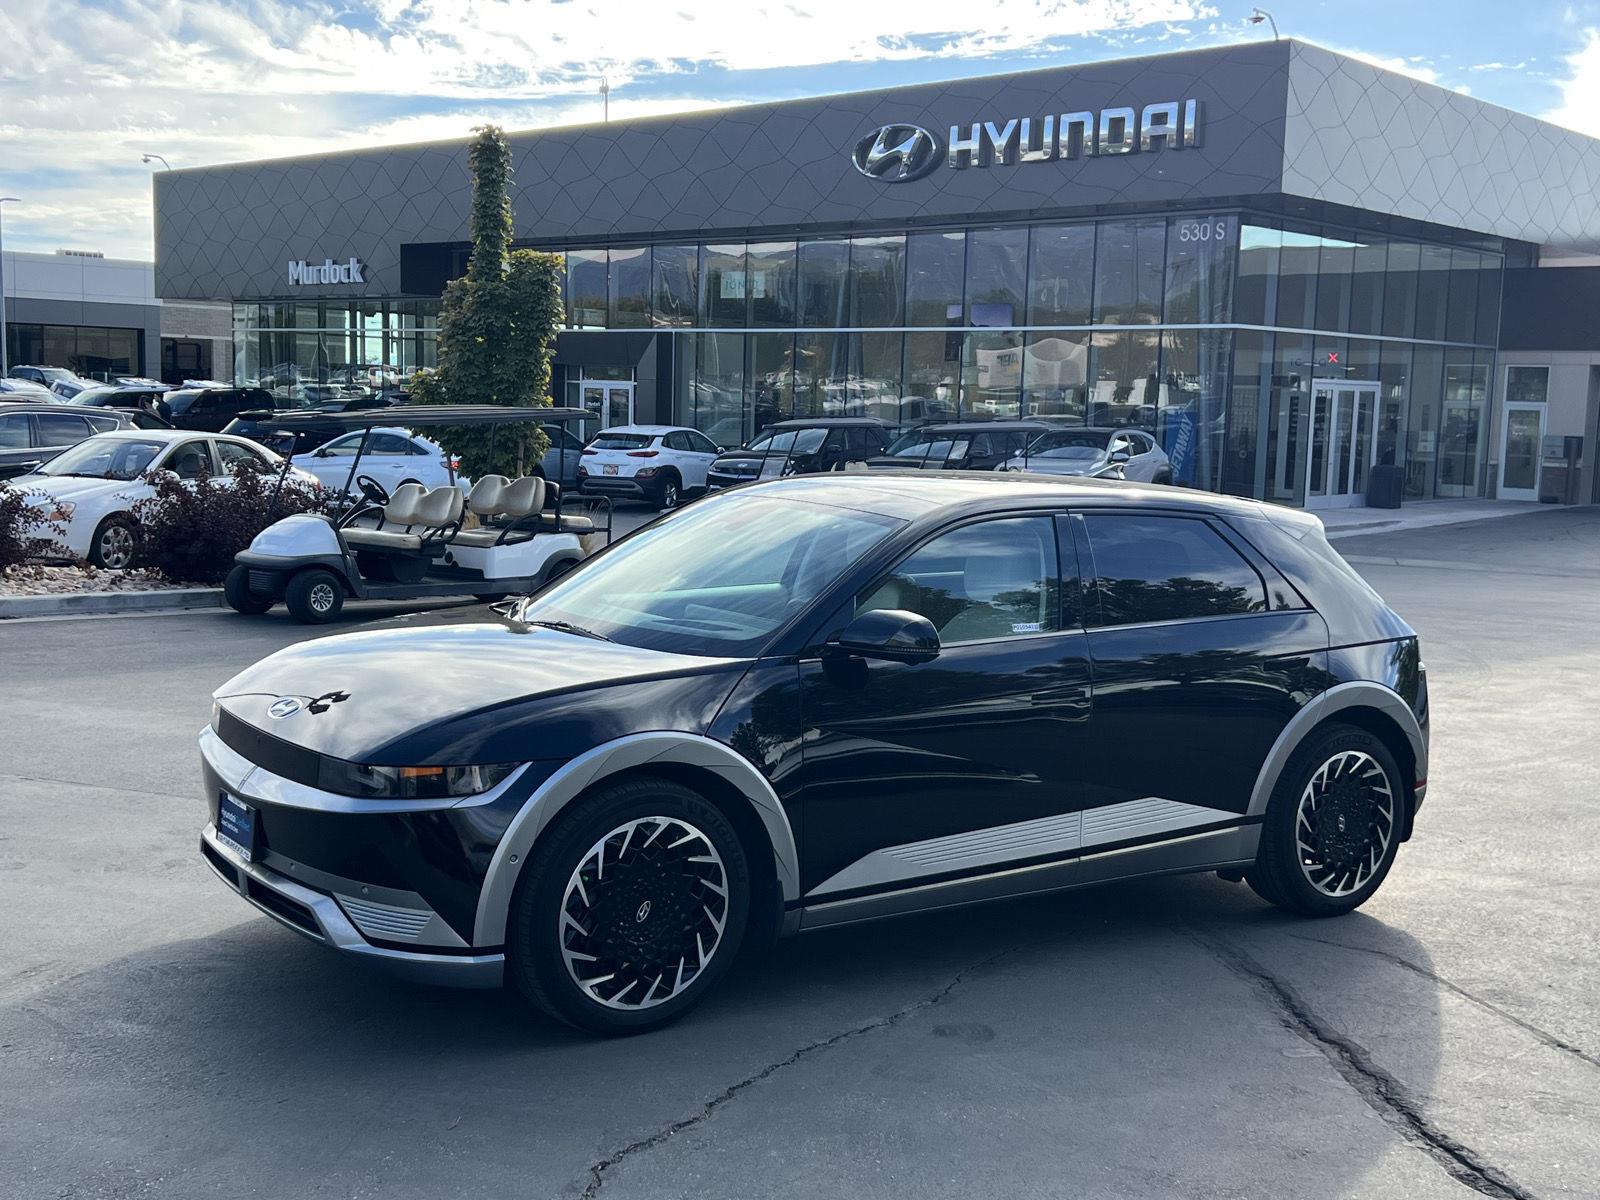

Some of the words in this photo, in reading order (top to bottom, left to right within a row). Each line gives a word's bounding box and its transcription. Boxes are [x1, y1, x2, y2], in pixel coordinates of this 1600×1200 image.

[948, 98, 1197, 168] HYUNDAI
[1180, 223, 1210, 242] 530
[1215, 222, 1225, 240] S
[288, 257, 365, 285] Murdock
